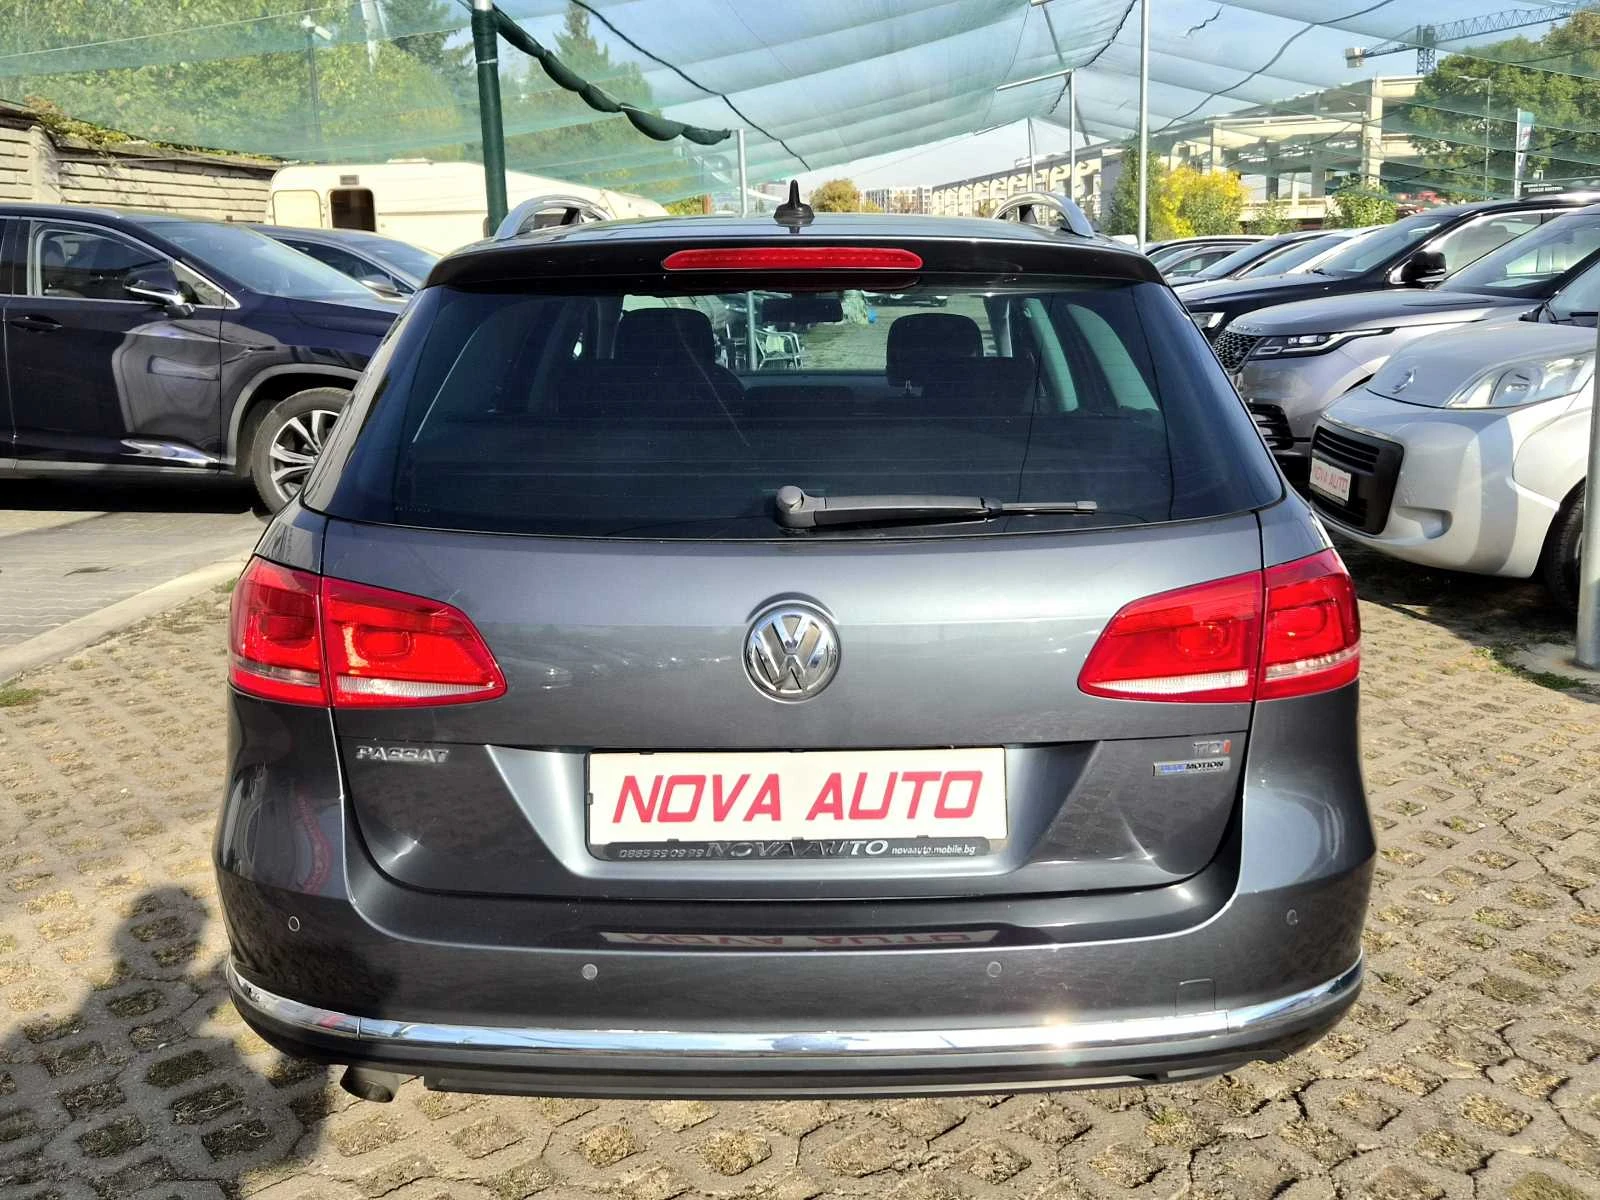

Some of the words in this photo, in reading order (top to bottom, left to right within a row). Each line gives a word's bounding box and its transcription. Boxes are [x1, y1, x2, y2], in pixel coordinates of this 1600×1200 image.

[356, 746, 449, 762] PASSAT
[611, 773, 782, 823] NOVA
[805, 771, 983, 821] AUTO
[705, 841, 796, 857] NOVA
[799, 839, 889, 856] AUTO
